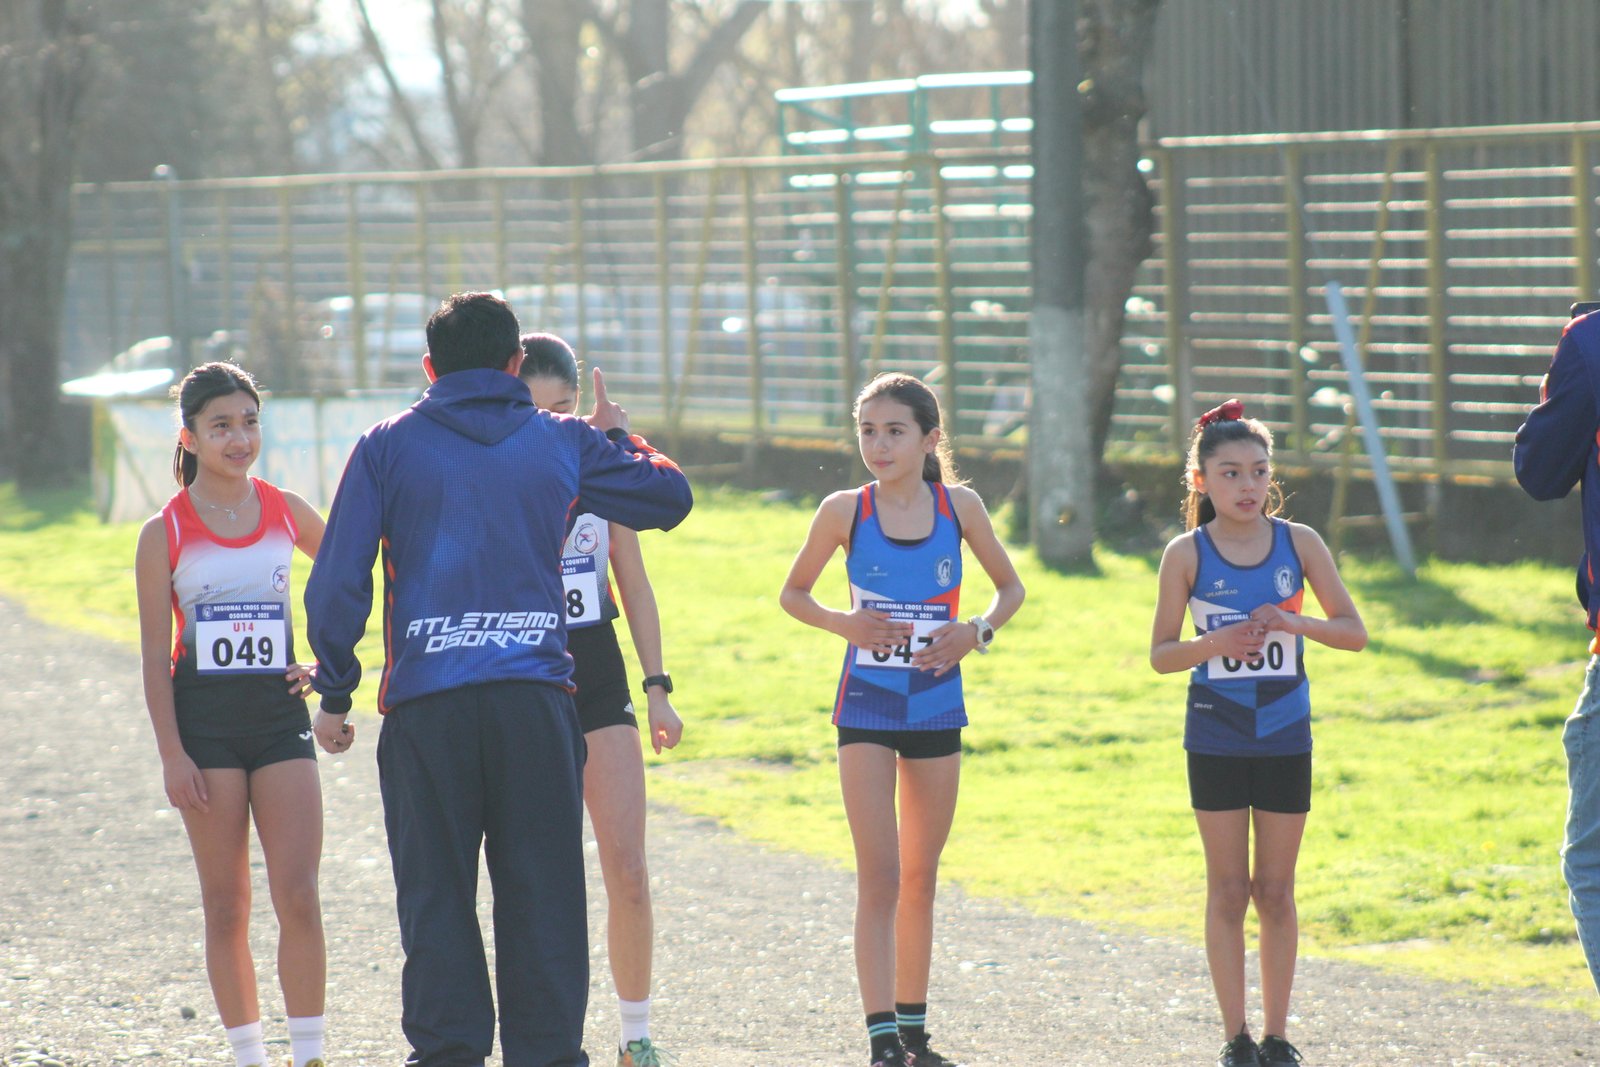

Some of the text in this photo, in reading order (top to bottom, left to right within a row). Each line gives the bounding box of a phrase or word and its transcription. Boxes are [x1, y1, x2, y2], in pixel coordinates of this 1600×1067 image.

[565, 557, 590, 566] COUNTRY
[213, 604, 241, 612] REGIONAL
[876, 602, 903, 610] REGIONAL
[891, 611, 914, 619] OSORNO
[1221, 613, 1249, 621] REGIONAL
[233, 622, 254, 633] U14
[406, 612, 559, 638] ATLETISMO
[425, 630, 546, 653] OSORNO
[212, 636, 273, 667] 049
